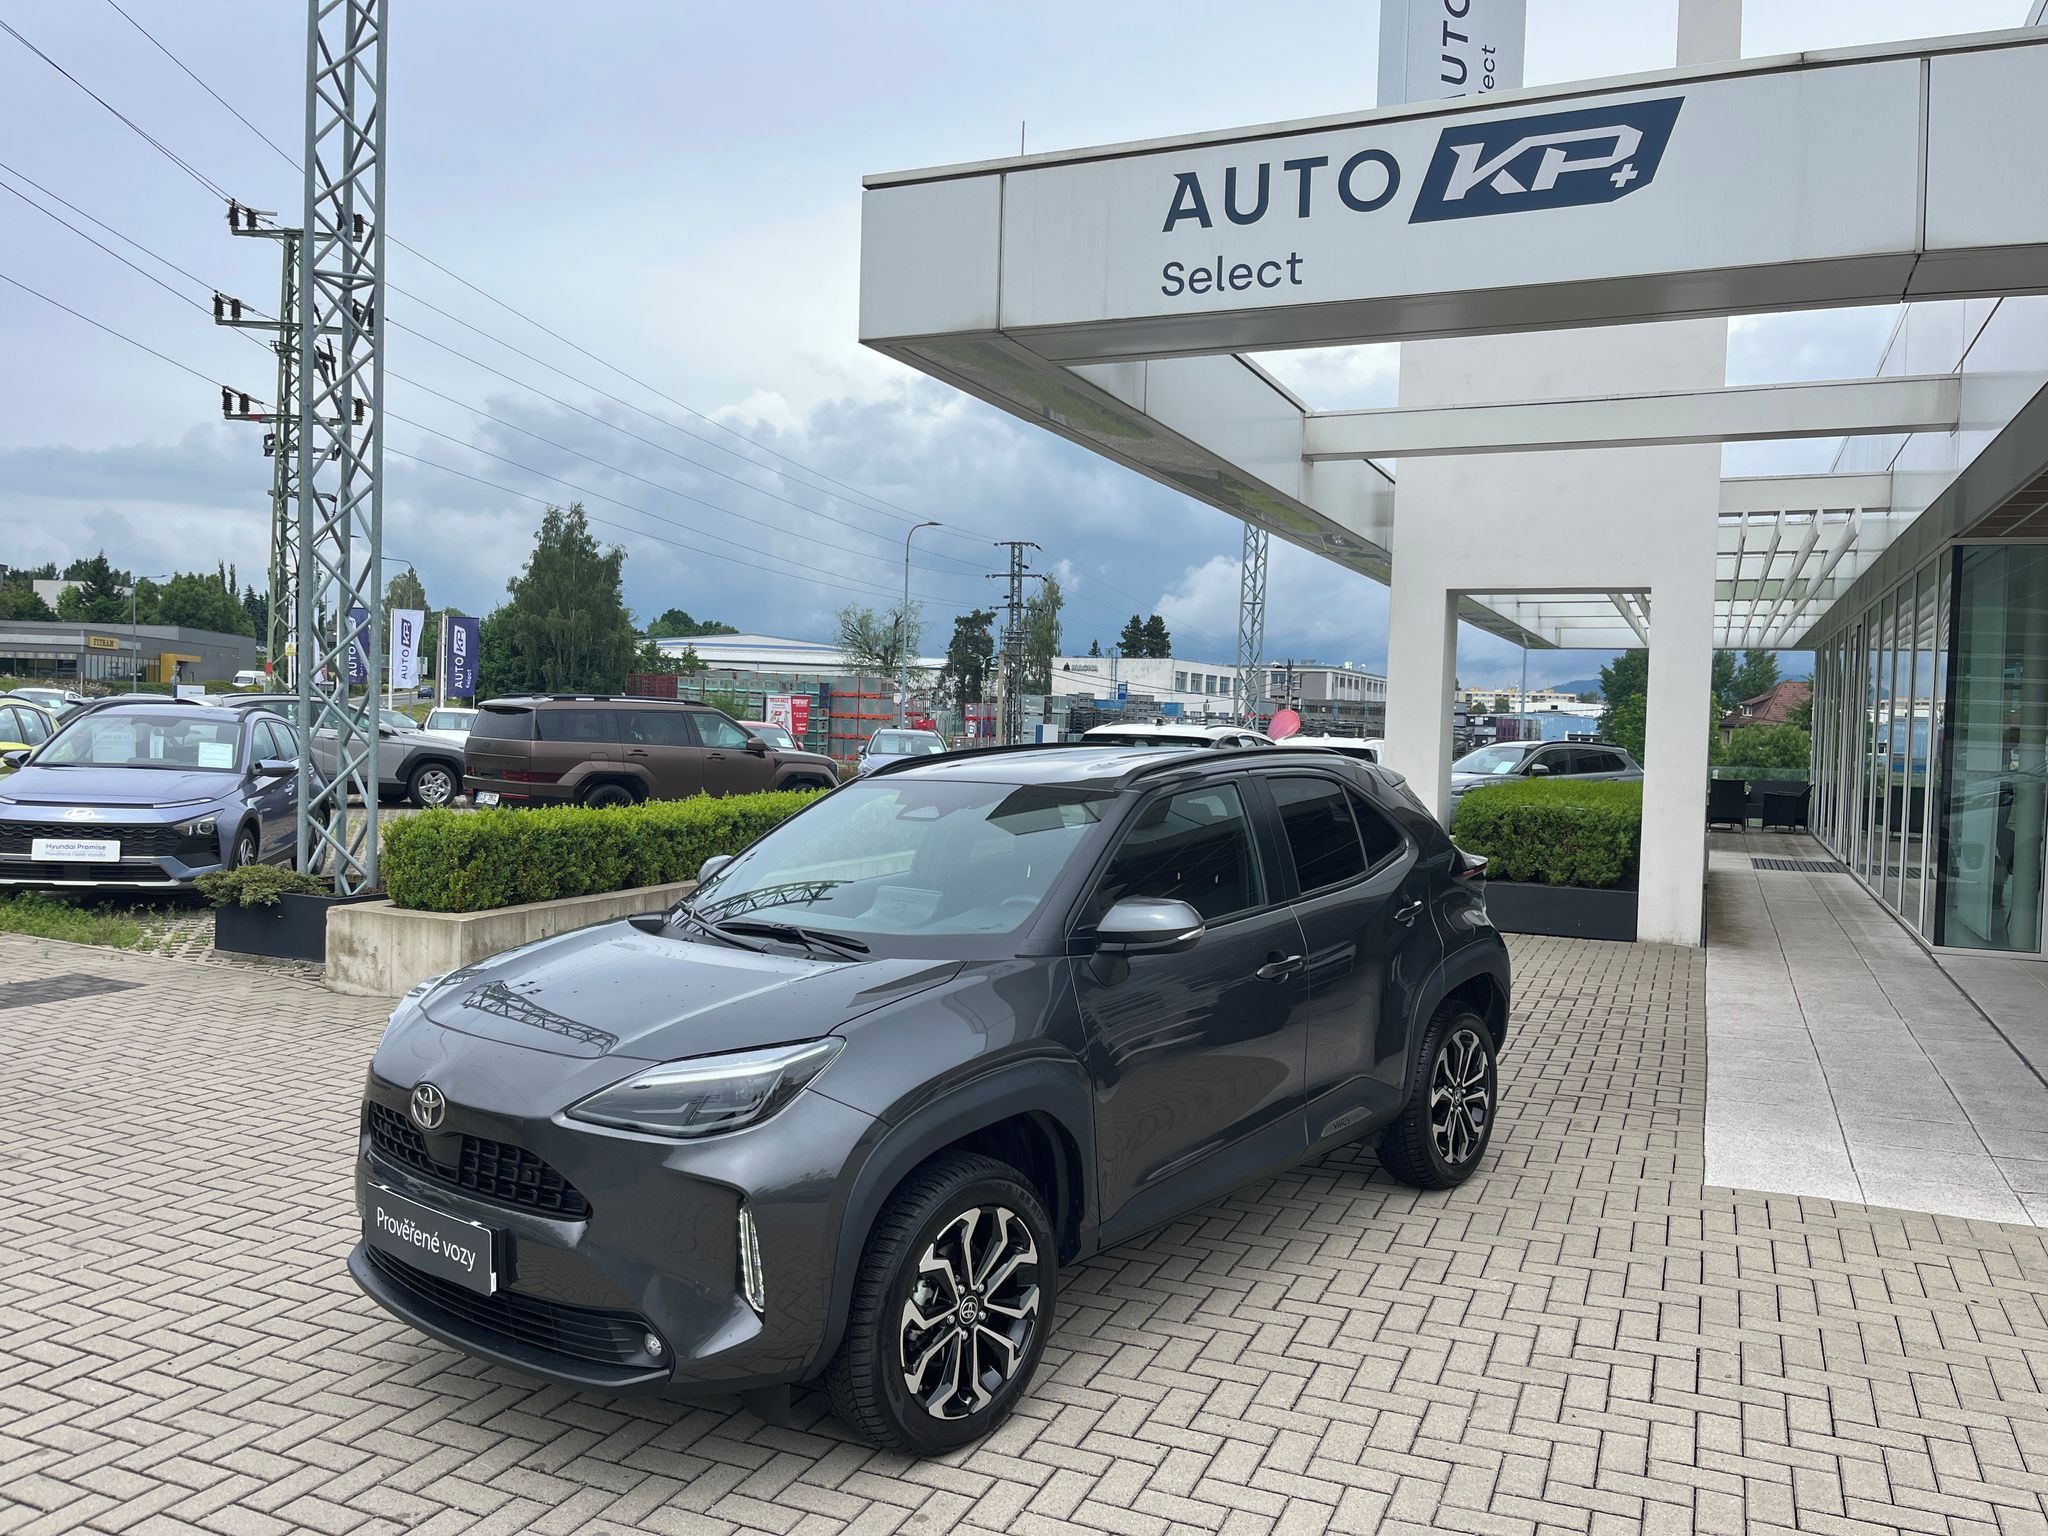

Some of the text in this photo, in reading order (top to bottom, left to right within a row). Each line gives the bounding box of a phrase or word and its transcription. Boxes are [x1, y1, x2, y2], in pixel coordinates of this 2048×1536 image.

[1162, 149, 1400, 233] AUTO
[1161, 252, 1304, 297] Select
[348, 645, 358, 677] AUTO
[401, 649, 410, 679] AUTO
[455, 657, 464, 689] AUTO
[45, 843, 76, 851] Hyundai
[377, 1206, 476, 1272] Prověřené vozy
